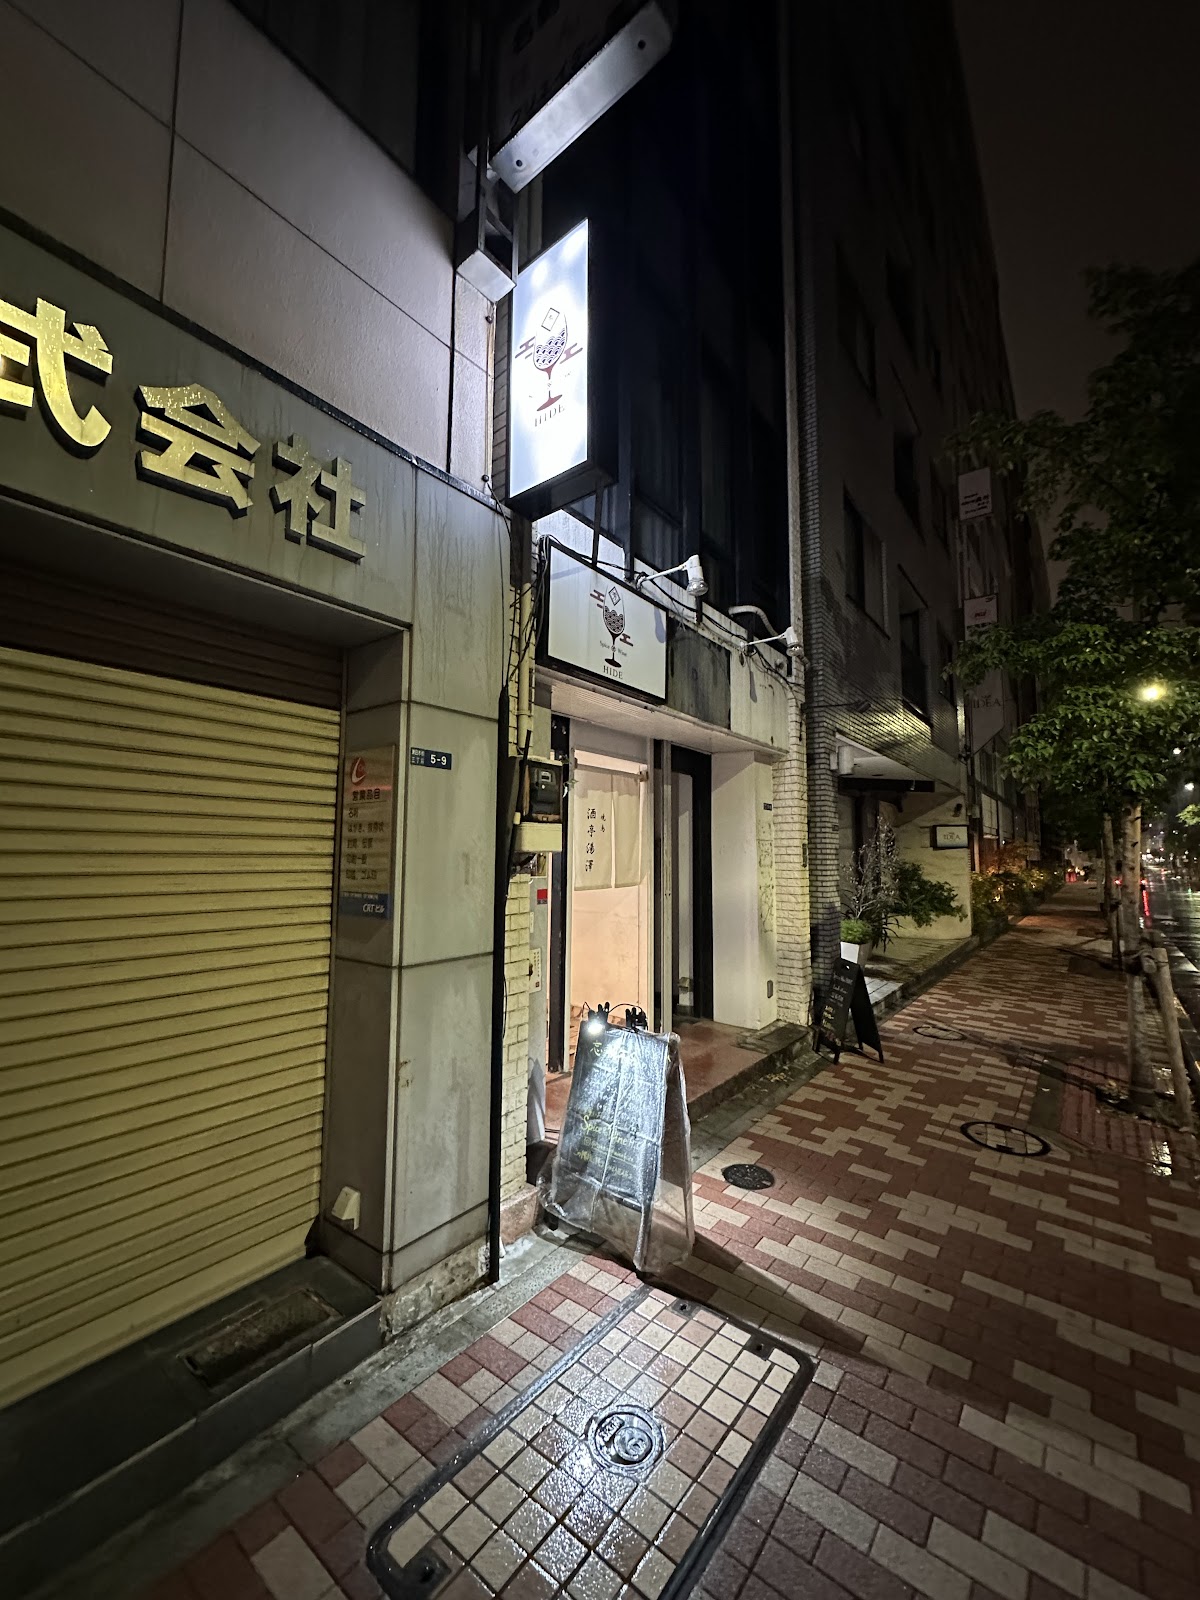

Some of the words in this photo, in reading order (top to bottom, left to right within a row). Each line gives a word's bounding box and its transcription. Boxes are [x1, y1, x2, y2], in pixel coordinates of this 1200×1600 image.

[0, 297, 367, 562] 式会社
[603, 665, 623, 680] HIDE
[430, 754, 447, 766] 5-9
